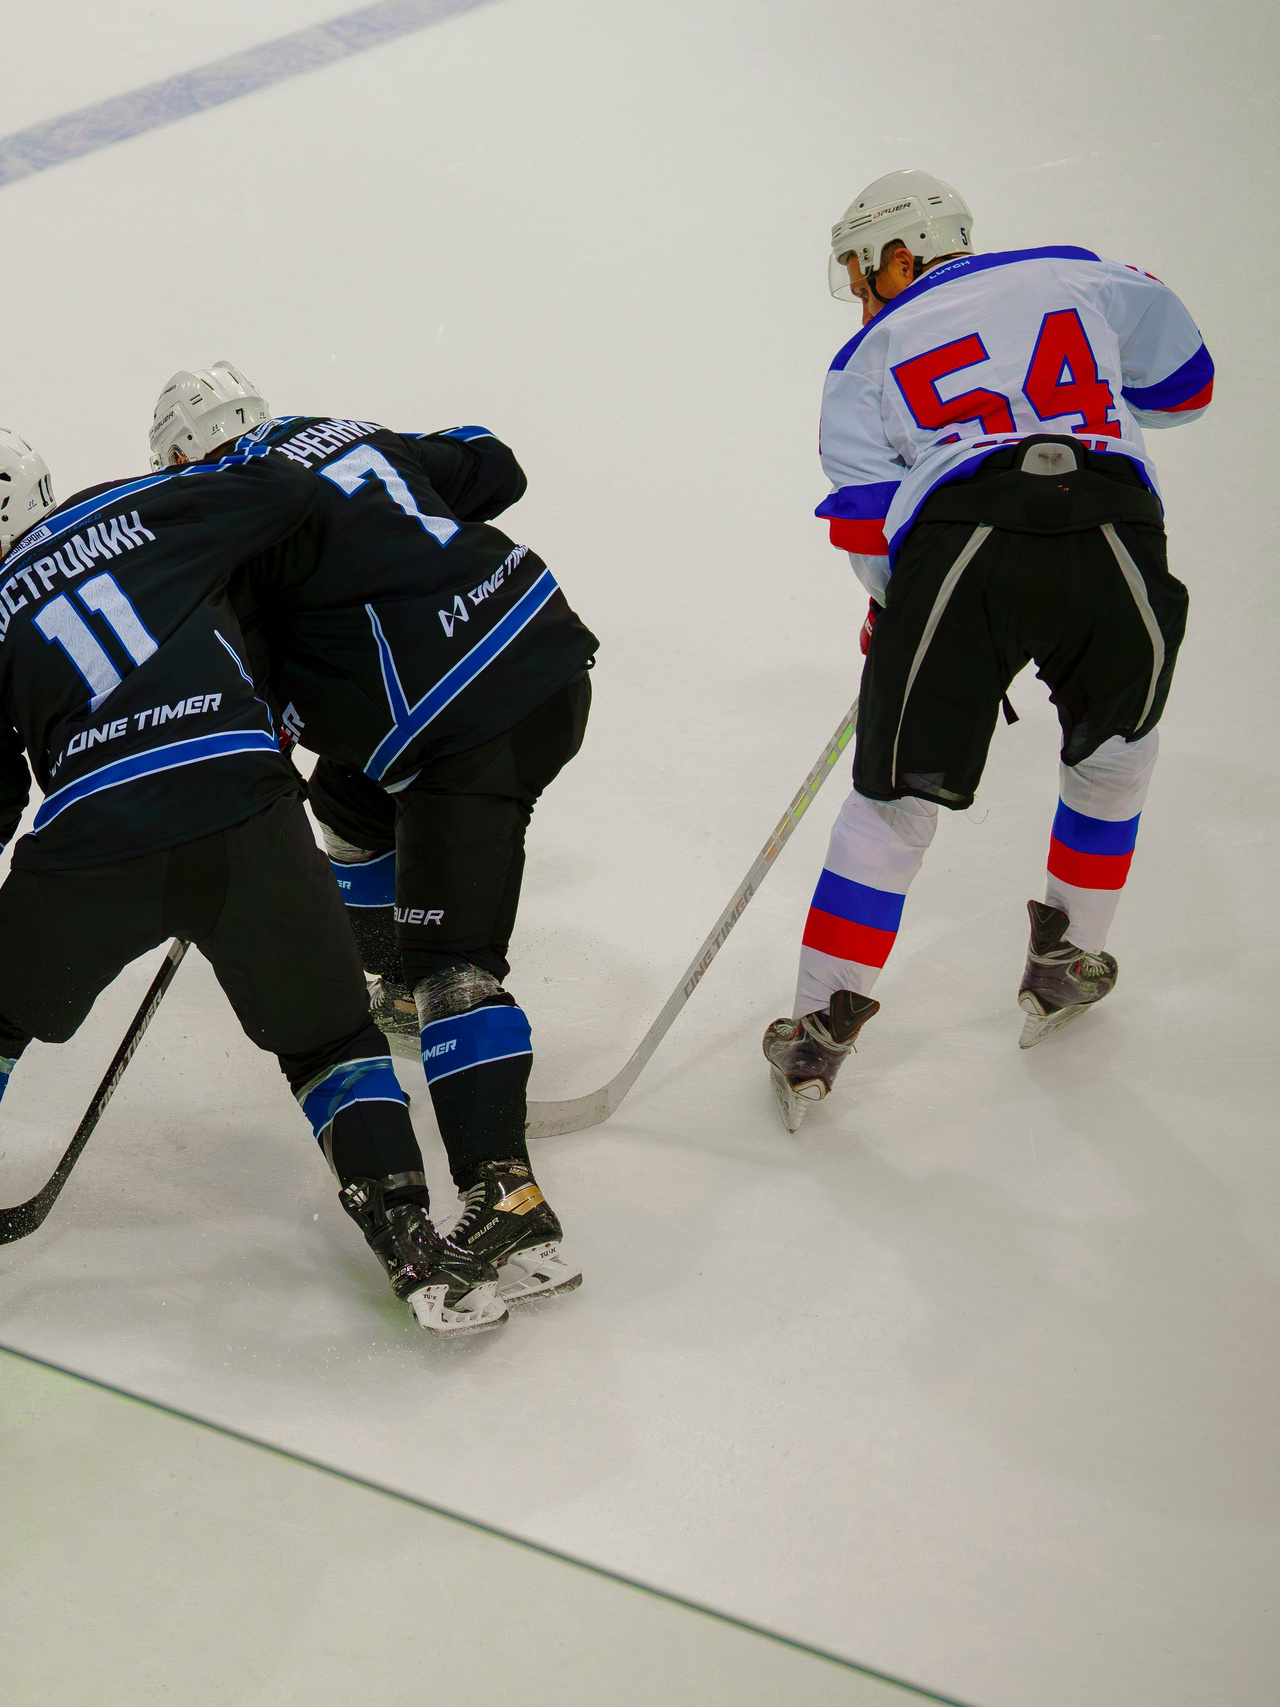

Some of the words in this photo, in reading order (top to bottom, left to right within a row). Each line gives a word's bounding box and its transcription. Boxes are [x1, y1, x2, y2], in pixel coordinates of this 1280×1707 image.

[873, 202, 911, 219] BAUER
[929, 260, 970, 280] LUTCH
[890, 308, 1121, 439] 54
[235, 408, 245, 424] 7
[316, 443, 462, 548] 7
[467, 565, 504, 606] ONE
[31, 570, 161, 716] 11
[66, 718, 128, 757] ONE
[134, 693, 222, 731] TIMER
[712, 883, 754, 949] TIMER
[468, 1217, 499, 1244] BAUER
